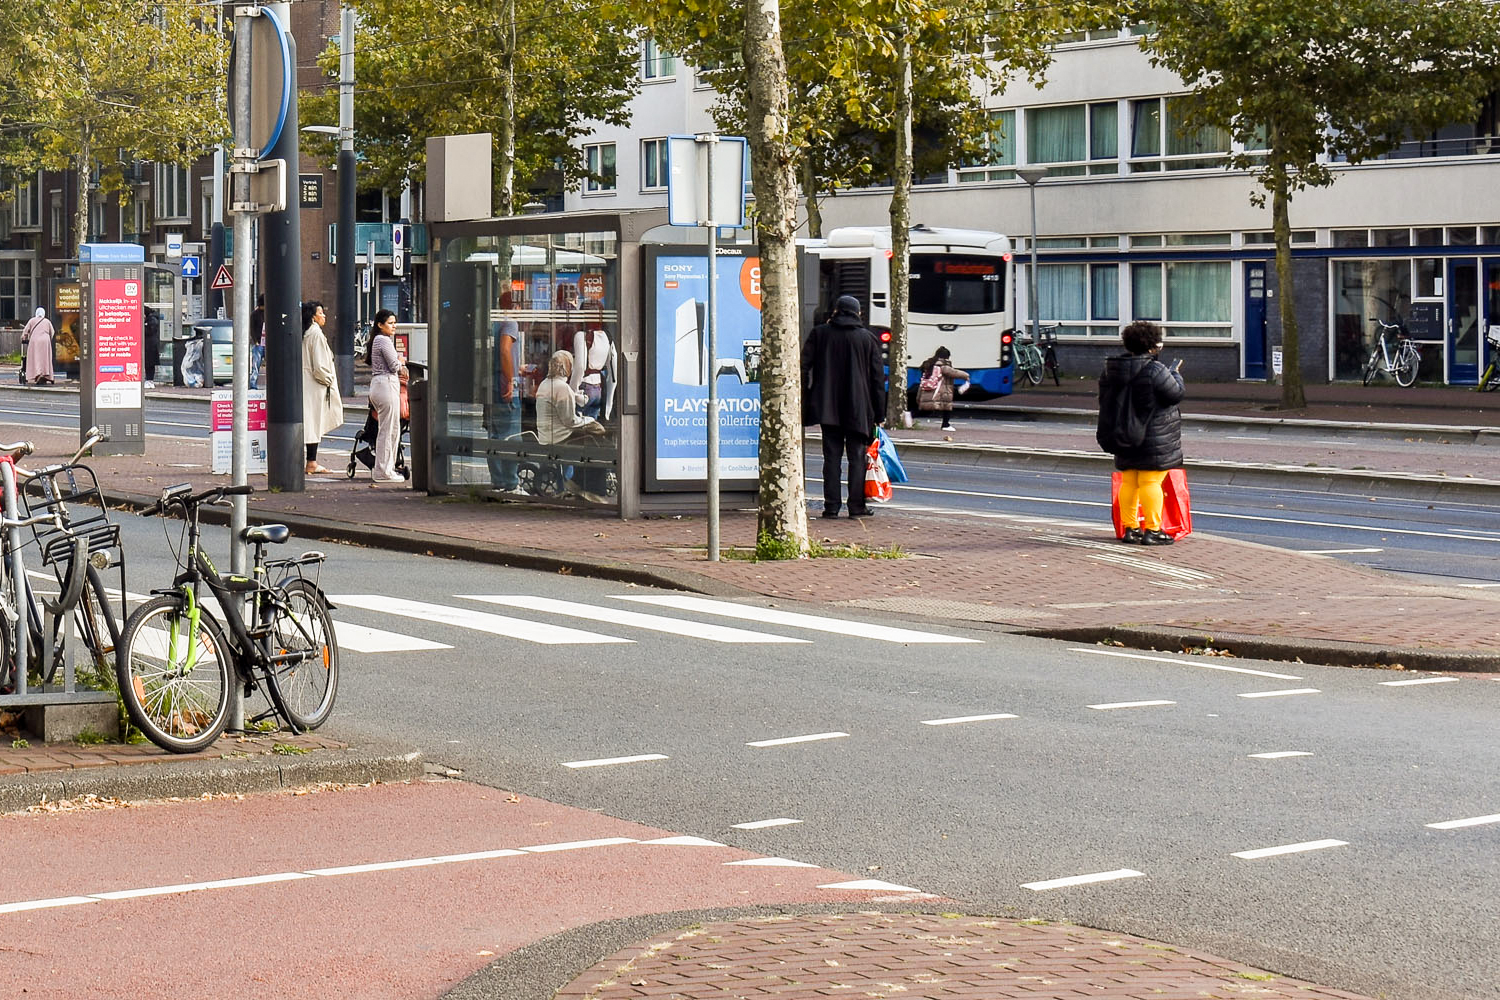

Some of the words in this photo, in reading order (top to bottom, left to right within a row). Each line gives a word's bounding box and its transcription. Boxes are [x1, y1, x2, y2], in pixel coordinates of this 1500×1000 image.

[664, 264, 693, 272] SONY
[664, 398, 761, 413] PLAYSATION
[664, 415, 690, 426] Voor
[728, 464, 753, 472] Coolblue
